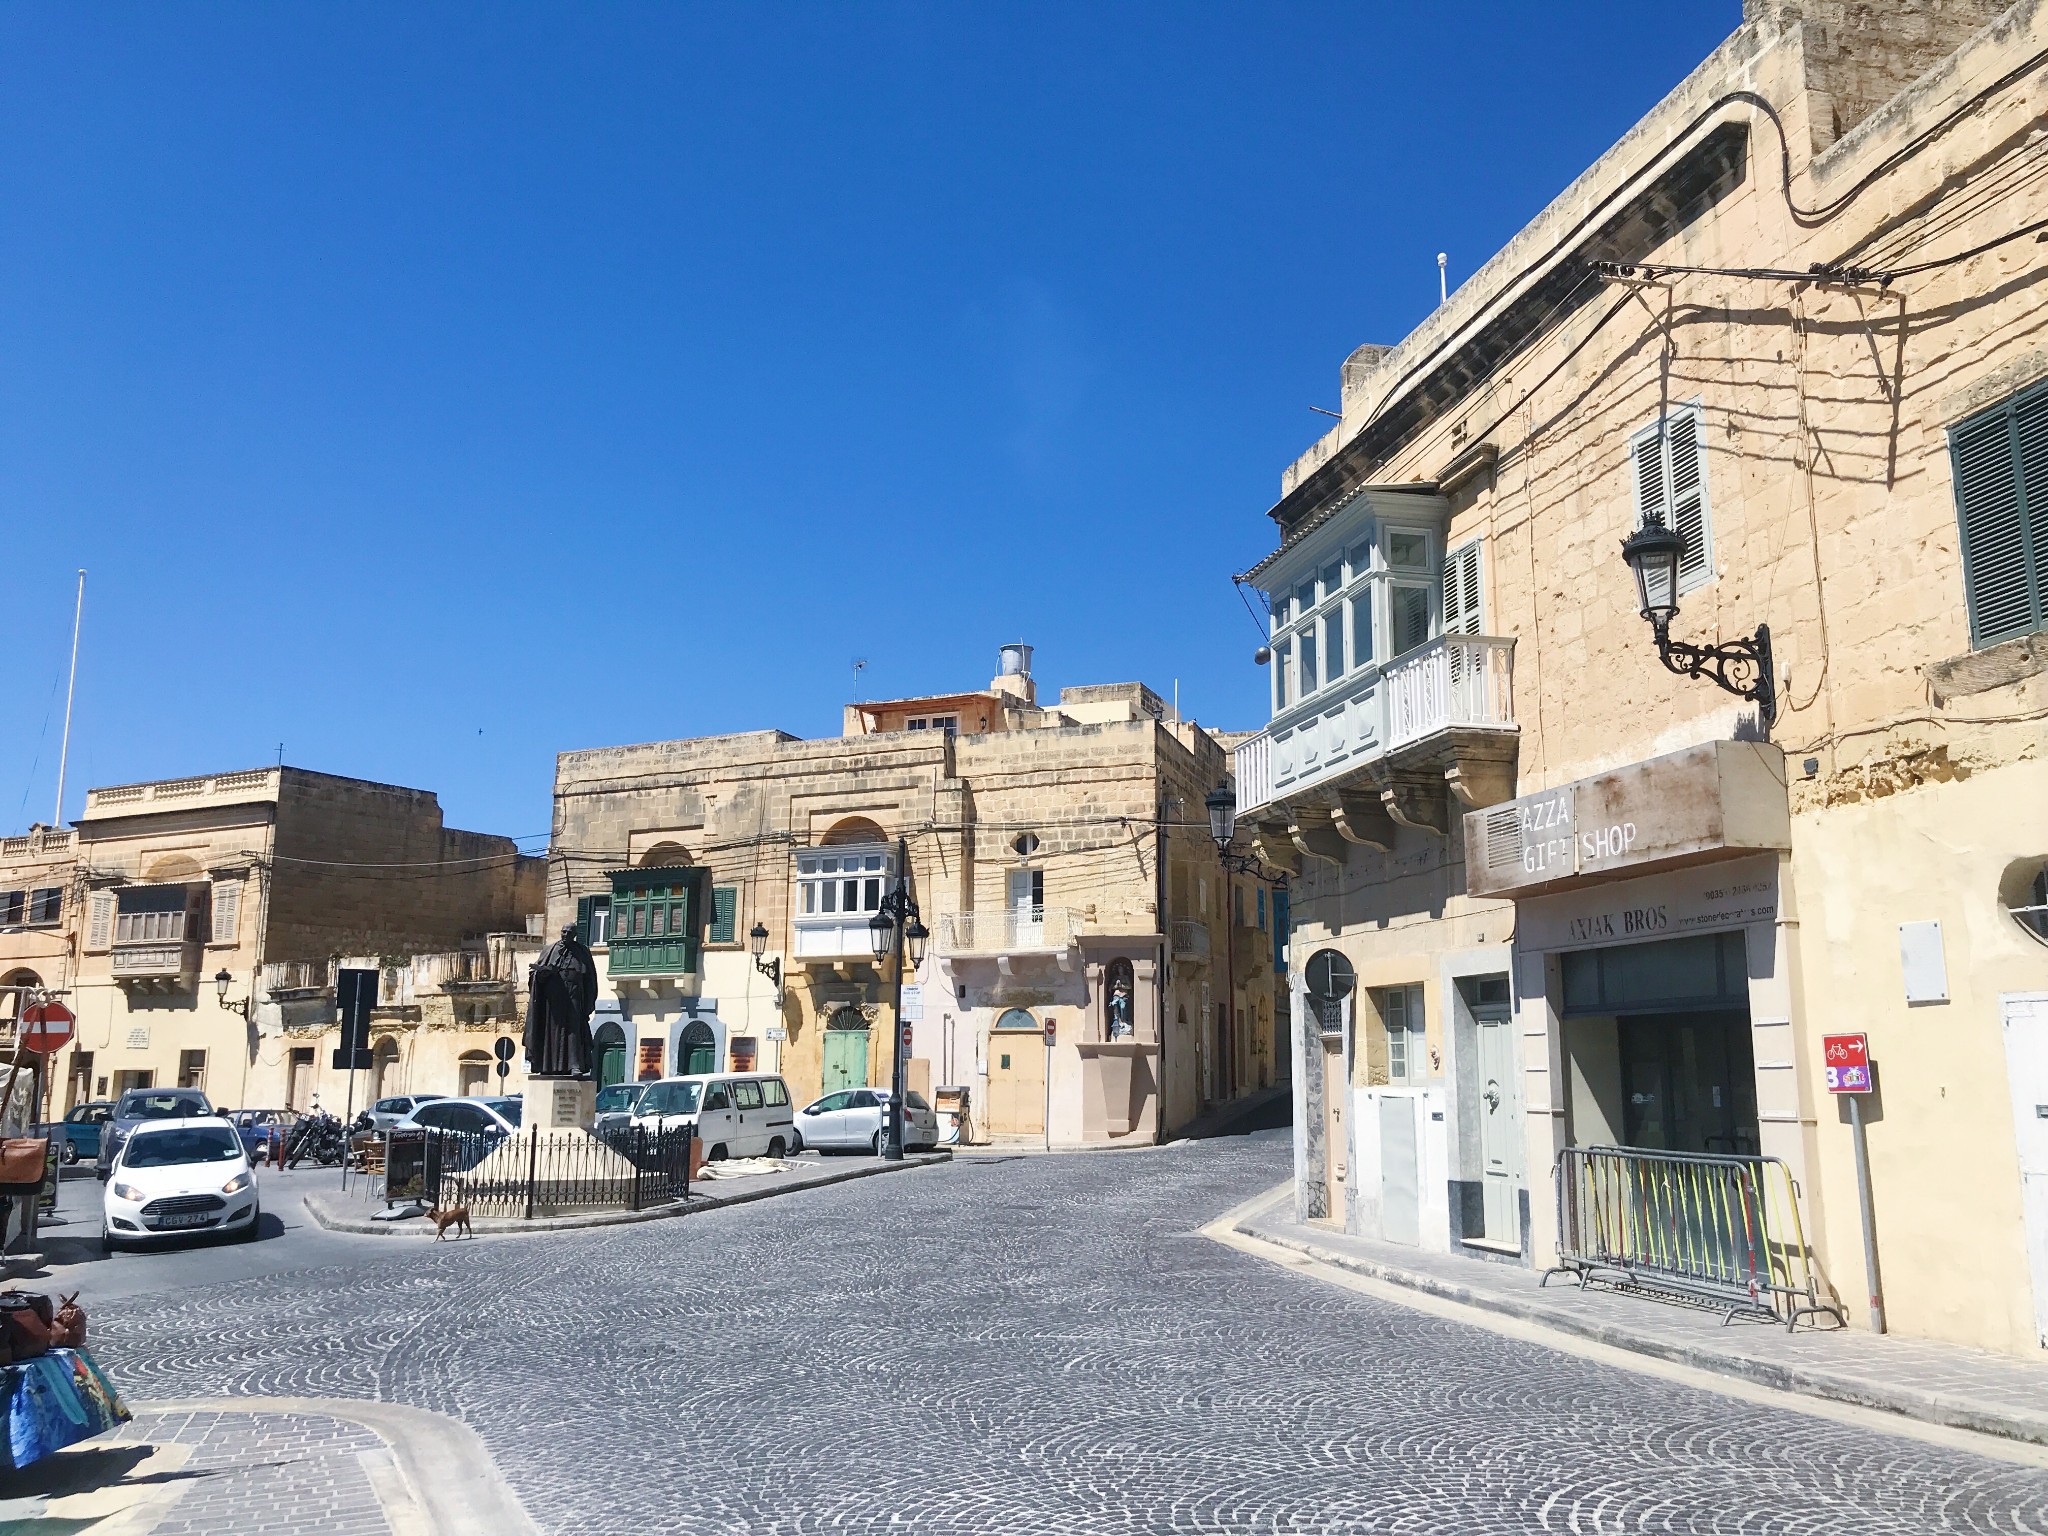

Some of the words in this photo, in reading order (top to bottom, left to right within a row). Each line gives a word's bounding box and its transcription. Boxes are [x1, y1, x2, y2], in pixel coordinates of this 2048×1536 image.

[1523, 838, 1571, 873] GIFT
[1582, 822, 1636, 862] SHOP
[1623, 905, 1667, 934] BROS
